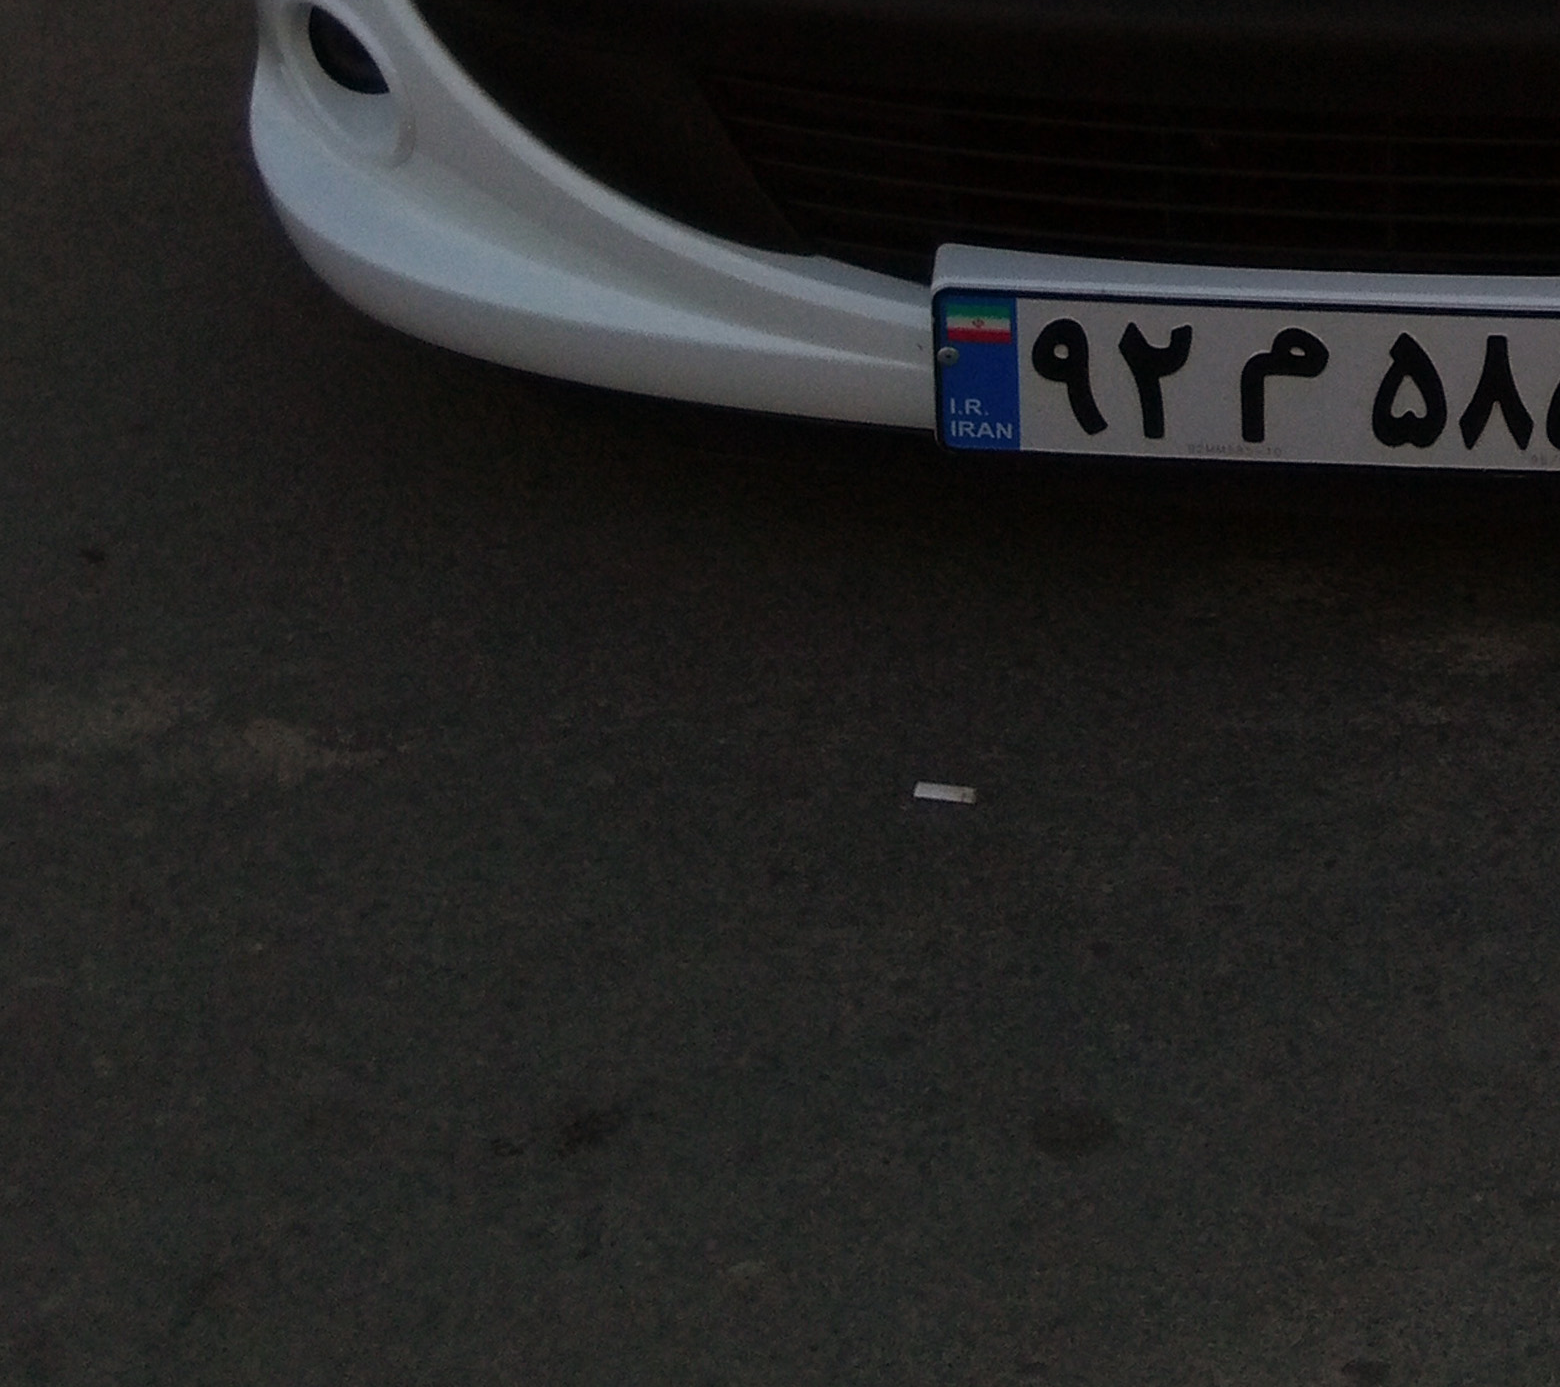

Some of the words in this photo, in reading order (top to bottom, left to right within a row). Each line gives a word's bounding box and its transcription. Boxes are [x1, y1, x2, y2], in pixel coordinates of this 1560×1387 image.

[1032, 318, 1192, 439] ۹۲
[1241, 328, 1329, 443] م
[950, 397, 989, 416] I.R.
[951, 420, 1013, 440] IRAN
